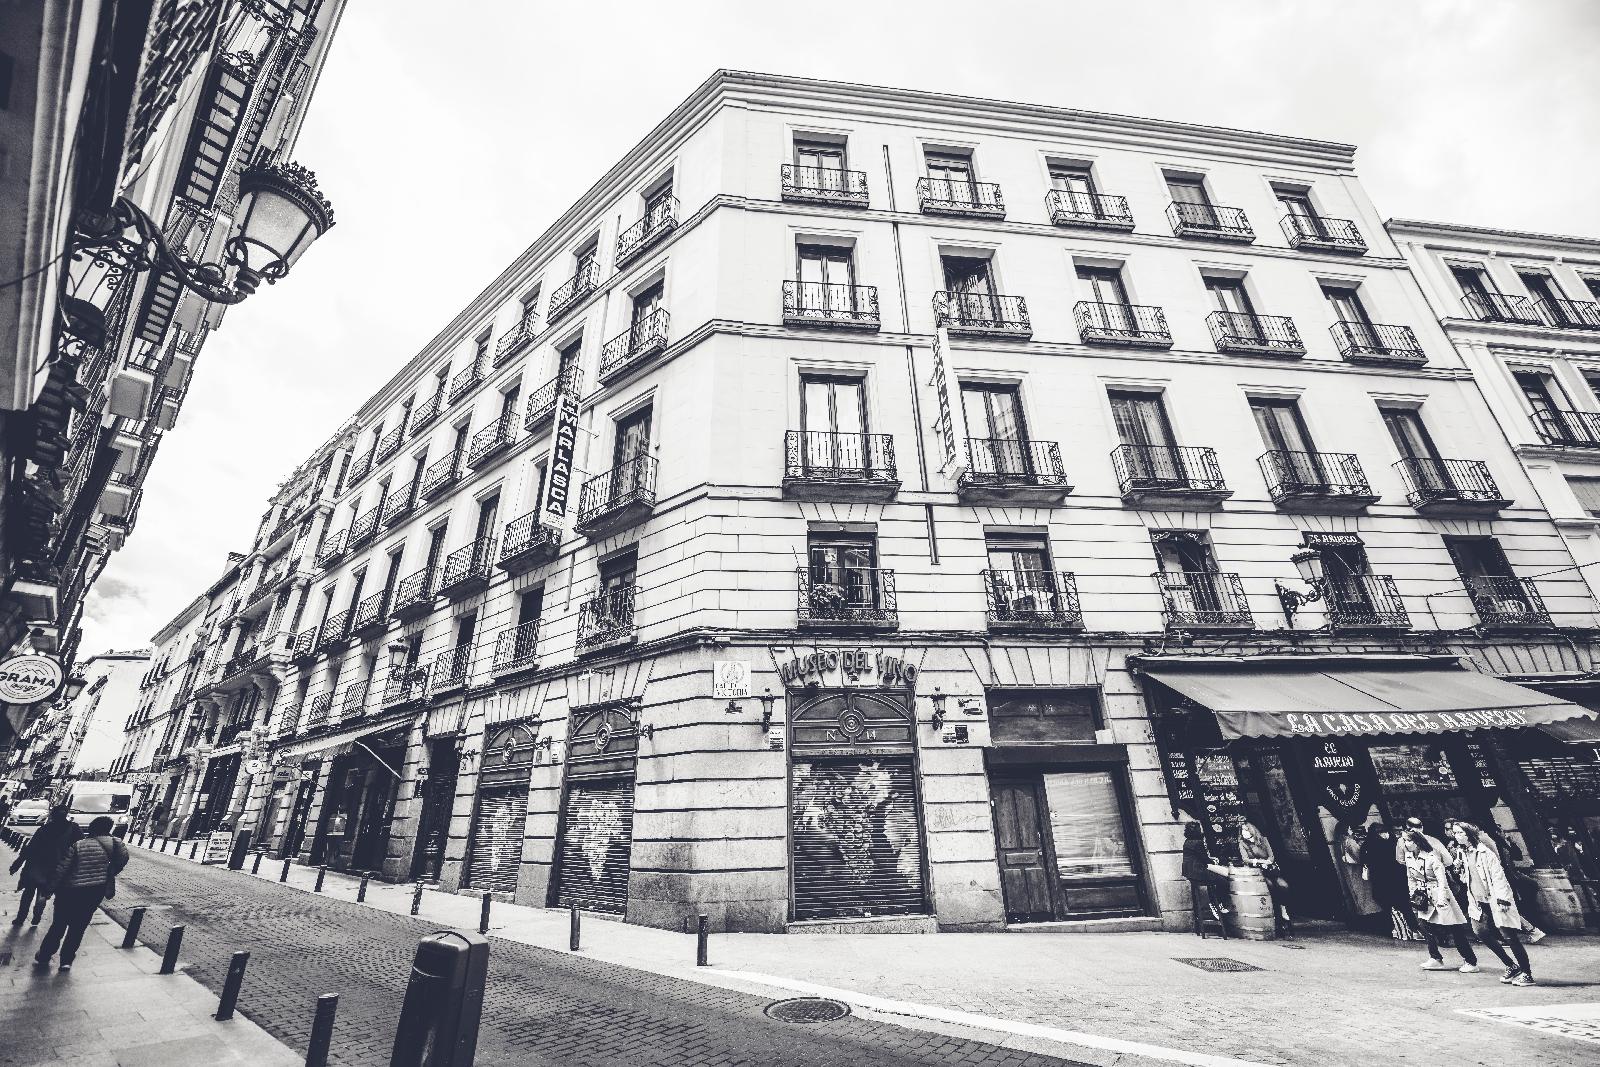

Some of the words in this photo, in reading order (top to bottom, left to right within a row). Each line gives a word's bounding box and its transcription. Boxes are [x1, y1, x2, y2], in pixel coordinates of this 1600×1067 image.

[547, 411, 577, 515] MARLASCA
[782, 651, 840, 682] MUSEO
[842, 650, 873, 671] DEL
[876, 653, 918, 682] VINO
[0, 671, 56, 689] GRAMA
[1287, 713, 1322, 732] LA
[1322, 713, 1392, 732] CASA
[1390, 712, 1440, 731] DEL
[1438, 709, 1528, 728] ABUELO
[1324, 742, 1337, 754] EL
[1314, 755, 1354, 768] ABUELO
